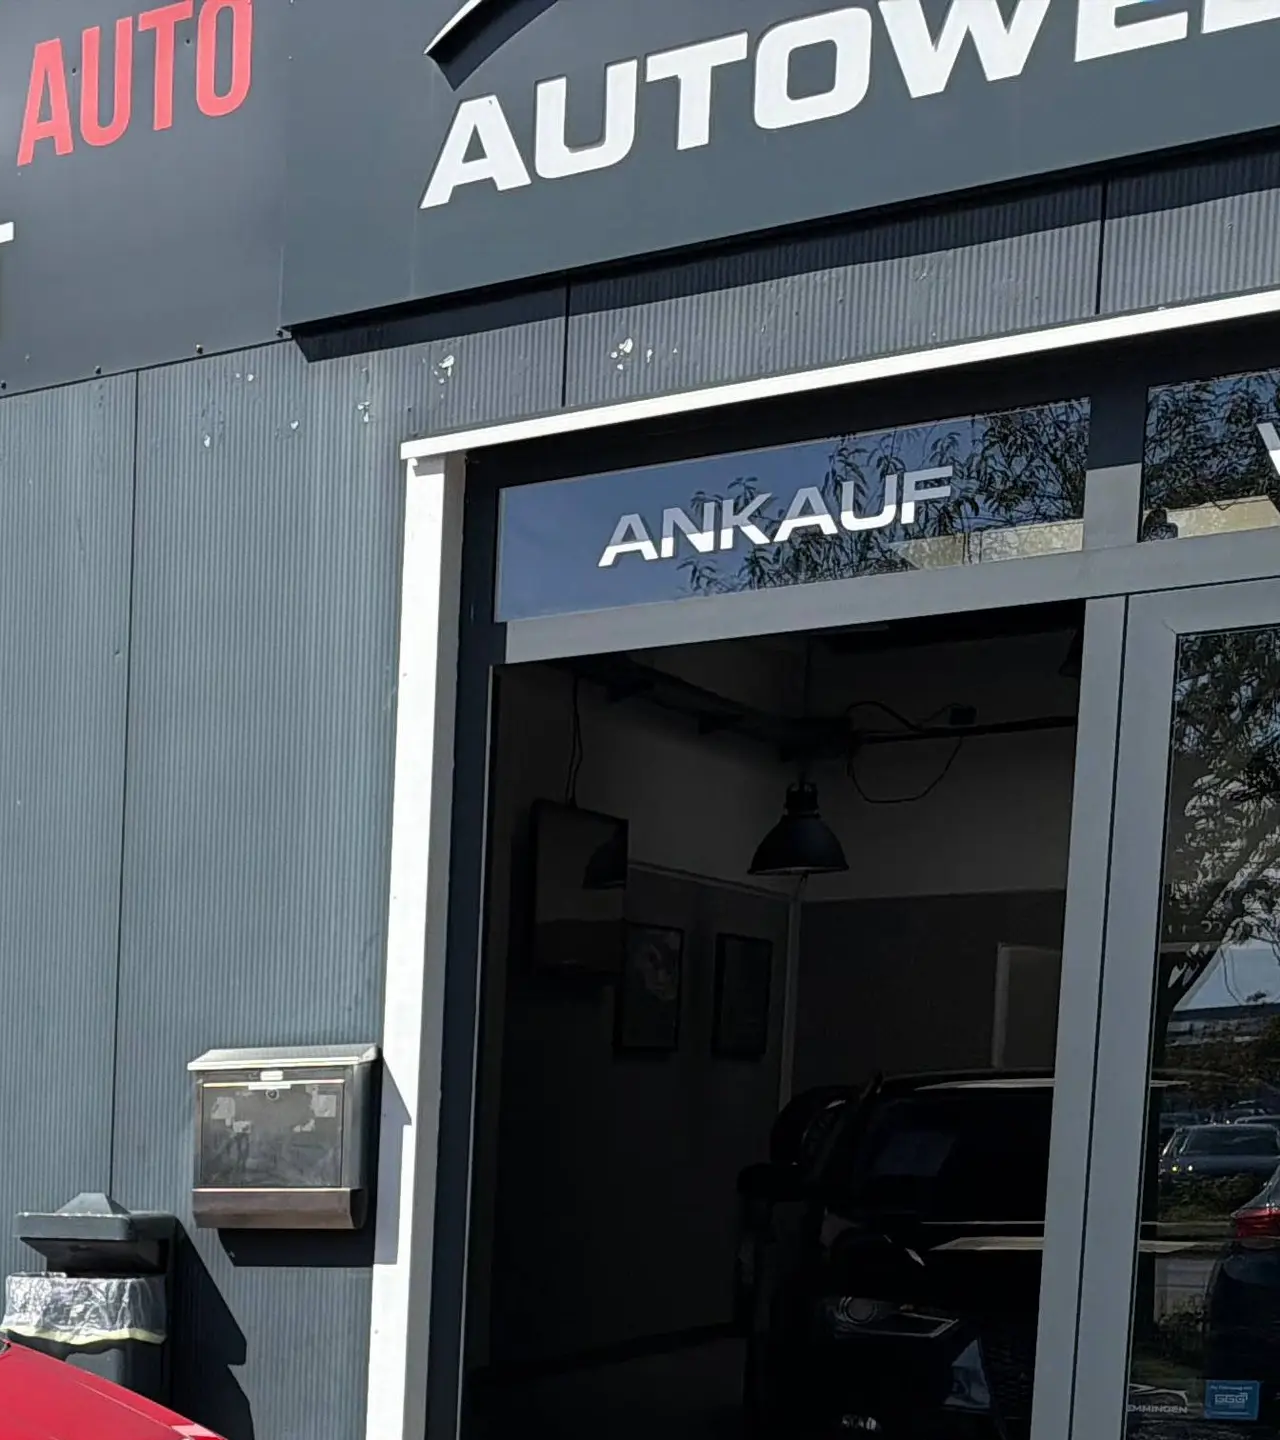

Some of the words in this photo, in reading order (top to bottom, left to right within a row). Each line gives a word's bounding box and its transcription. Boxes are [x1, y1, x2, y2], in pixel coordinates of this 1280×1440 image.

[17, 0, 253, 165] AUTO
[421, 0, 1280, 209] AUTOW
[597, 466, 952, 567] ANKAUF
